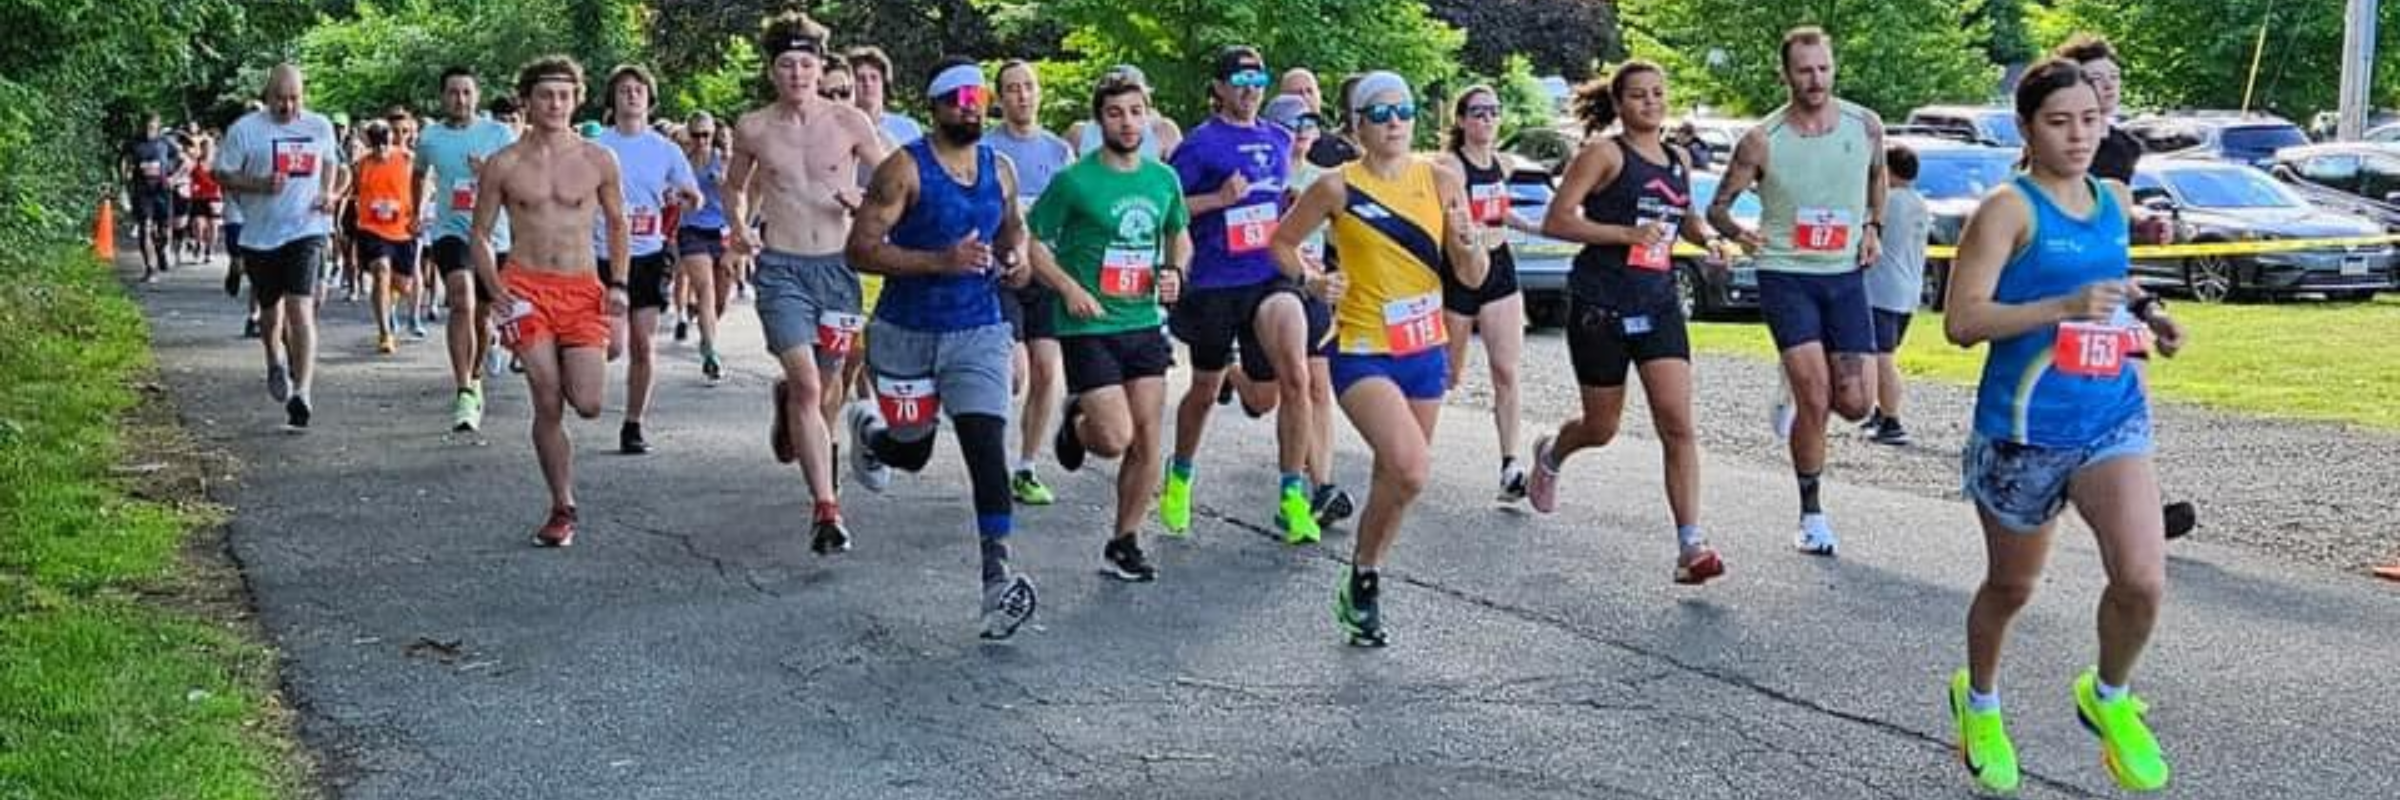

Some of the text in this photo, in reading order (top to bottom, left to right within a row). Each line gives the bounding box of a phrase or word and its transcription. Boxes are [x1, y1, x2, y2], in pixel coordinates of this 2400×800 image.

[1811, 226, 1833, 247] 67
[2079, 331, 2119, 368] 153
[890, 398, 919, 423] 70
